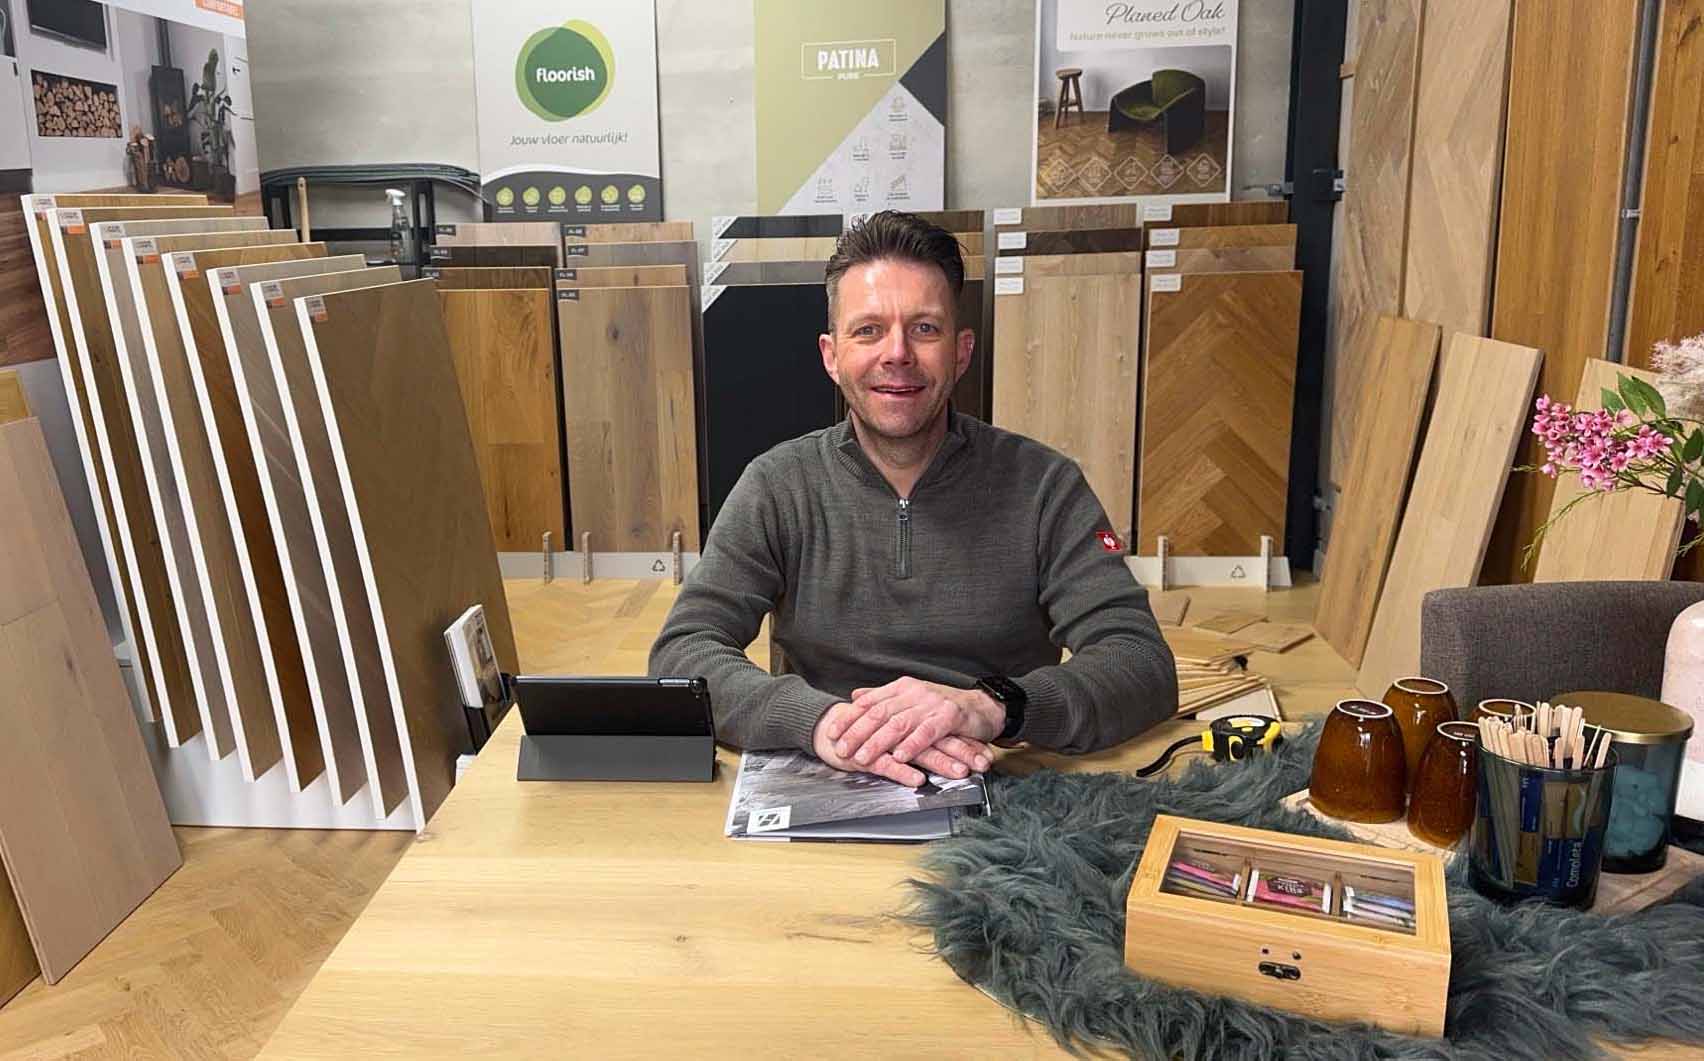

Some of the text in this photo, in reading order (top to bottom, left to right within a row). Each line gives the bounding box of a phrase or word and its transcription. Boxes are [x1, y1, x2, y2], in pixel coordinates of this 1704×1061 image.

[1105, 0, 1226, 25] Planed Oak
[1069, 31, 1101, 41] Nature
[1102, 32, 1132, 40] never
[1134, 31, 1165, 41] grows
[1167, 29, 1184, 39] out
[1186, 28, 1197, 38] of
[817, 48, 880, 70] PATINA
[536, 66, 595, 83] floorish
[510, 131, 628, 146] Jouw vloer natuurlijk!
